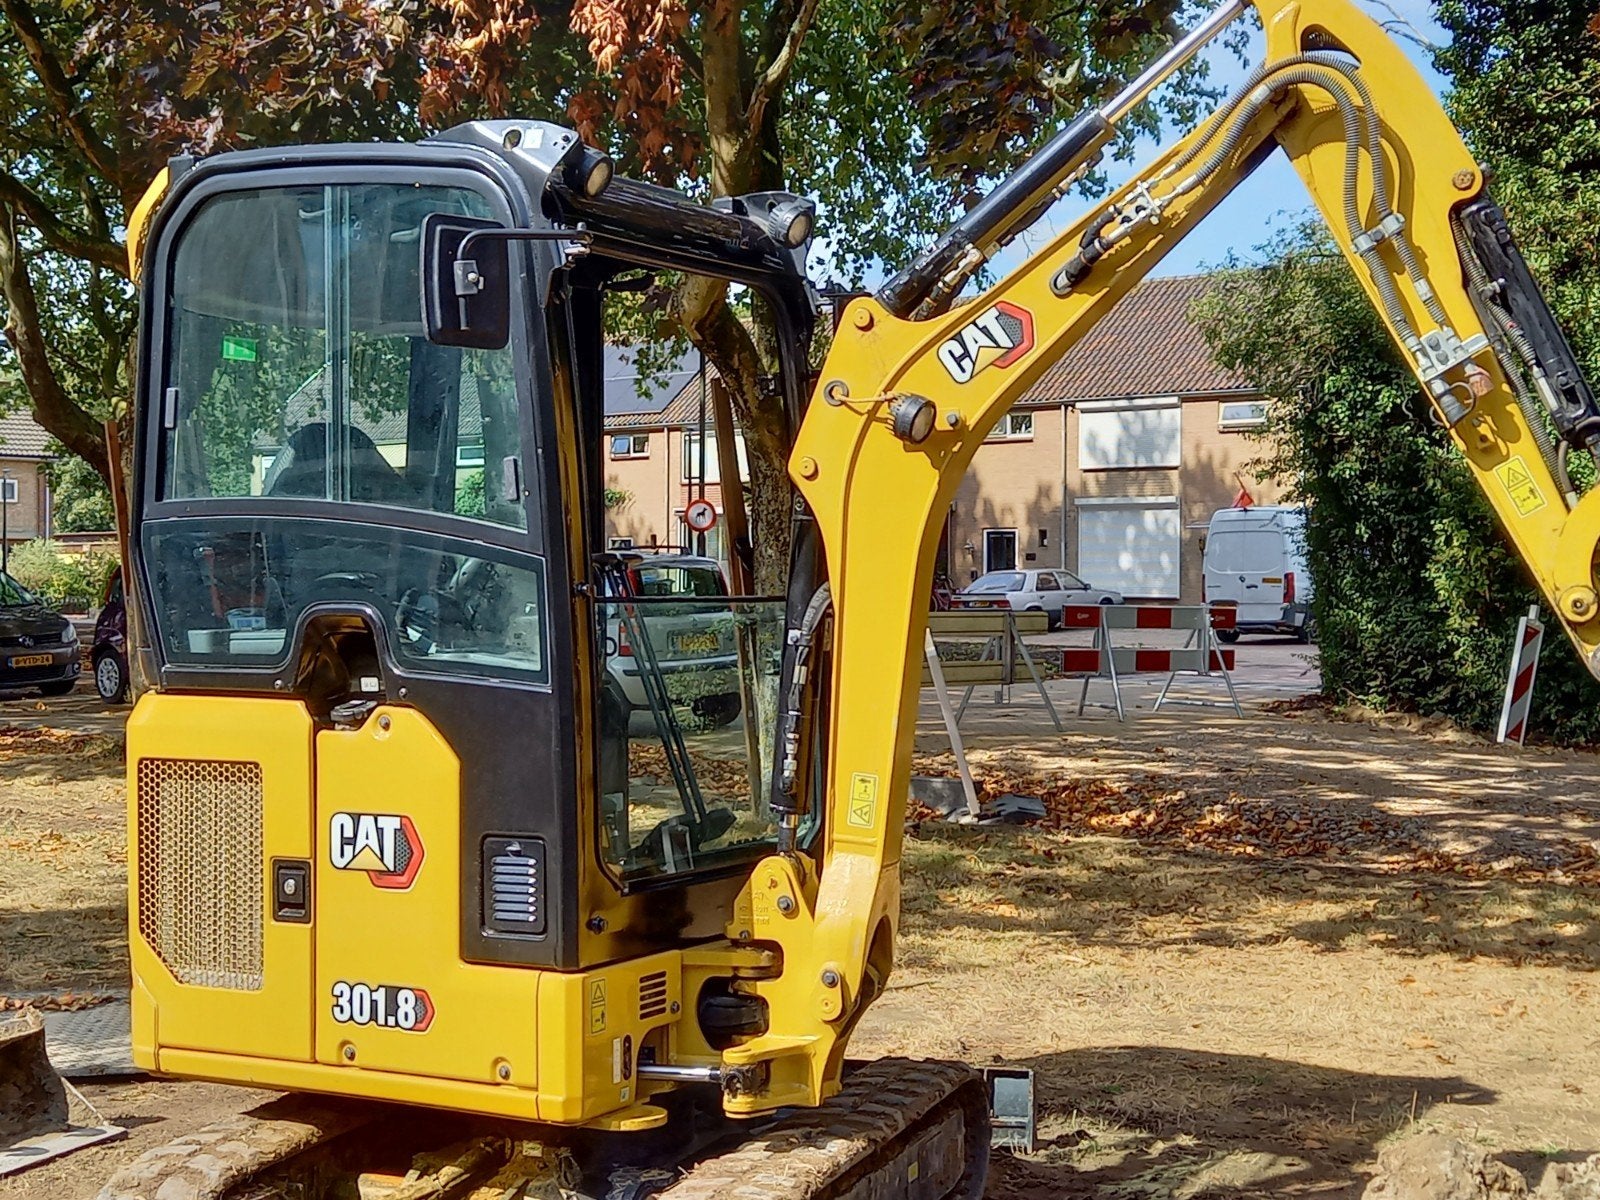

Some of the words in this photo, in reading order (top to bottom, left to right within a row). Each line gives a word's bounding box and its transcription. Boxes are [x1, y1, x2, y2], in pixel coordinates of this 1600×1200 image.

[937, 306, 1015, 384] CAT
[330, 812, 401, 872] CAT
[332, 981, 417, 1030] 301.8
